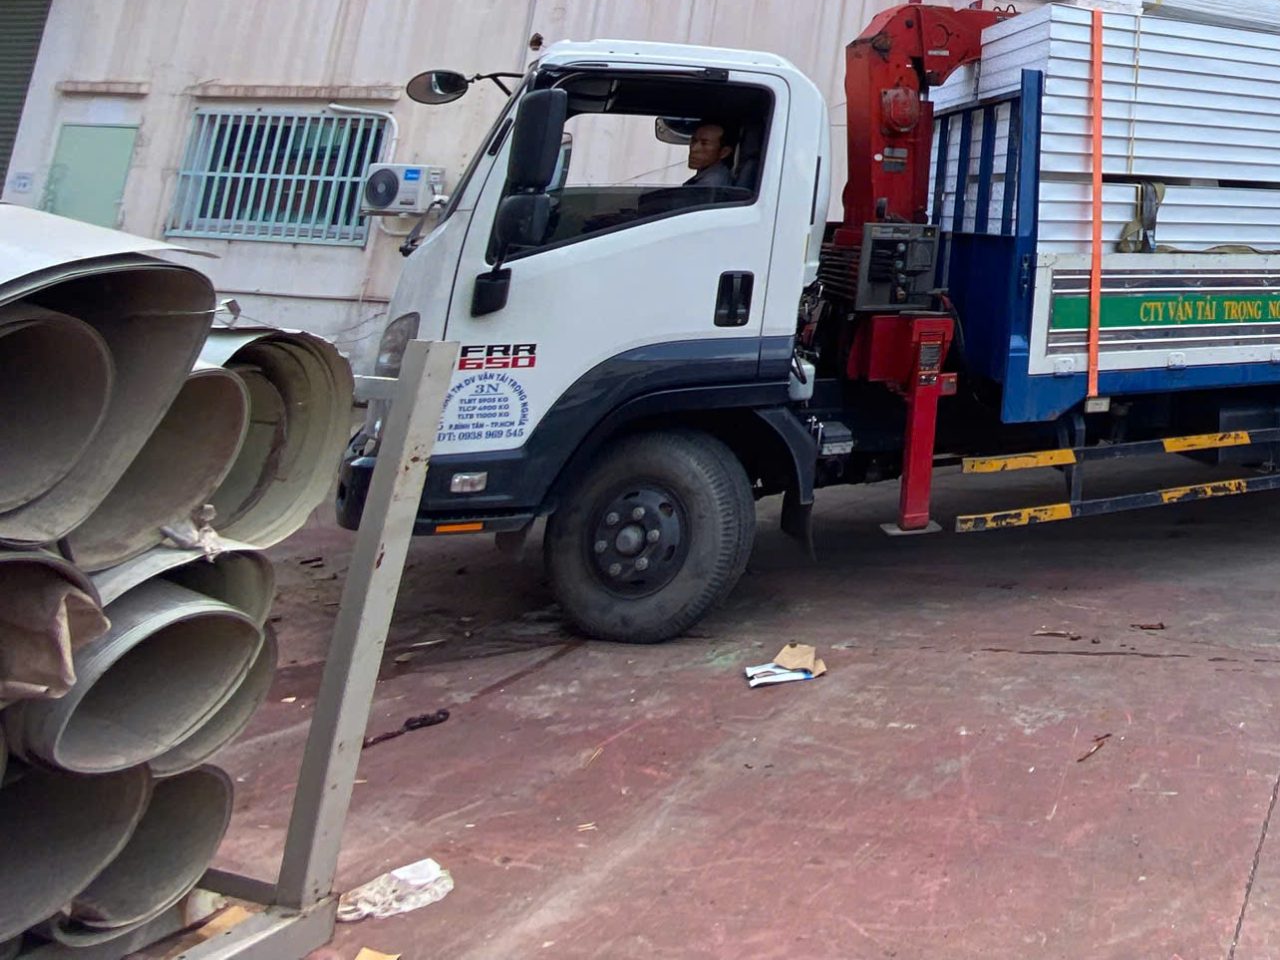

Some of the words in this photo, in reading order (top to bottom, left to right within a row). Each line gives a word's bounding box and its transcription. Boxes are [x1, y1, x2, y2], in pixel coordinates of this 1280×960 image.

[1140, 301, 1165, 322] CTY
[1168, 295, 1193, 325] VẬN
[1197, 295, 1216, 320] TẢI
[1224, 300, 1262, 323] TRỌNG
[460, 344, 537, 357] FRR
[458, 356, 536, 370] 650
[474, 383, 500, 394] 3N
[458, 430, 482, 440] 0938
[505, 428, 524, 438] 545
